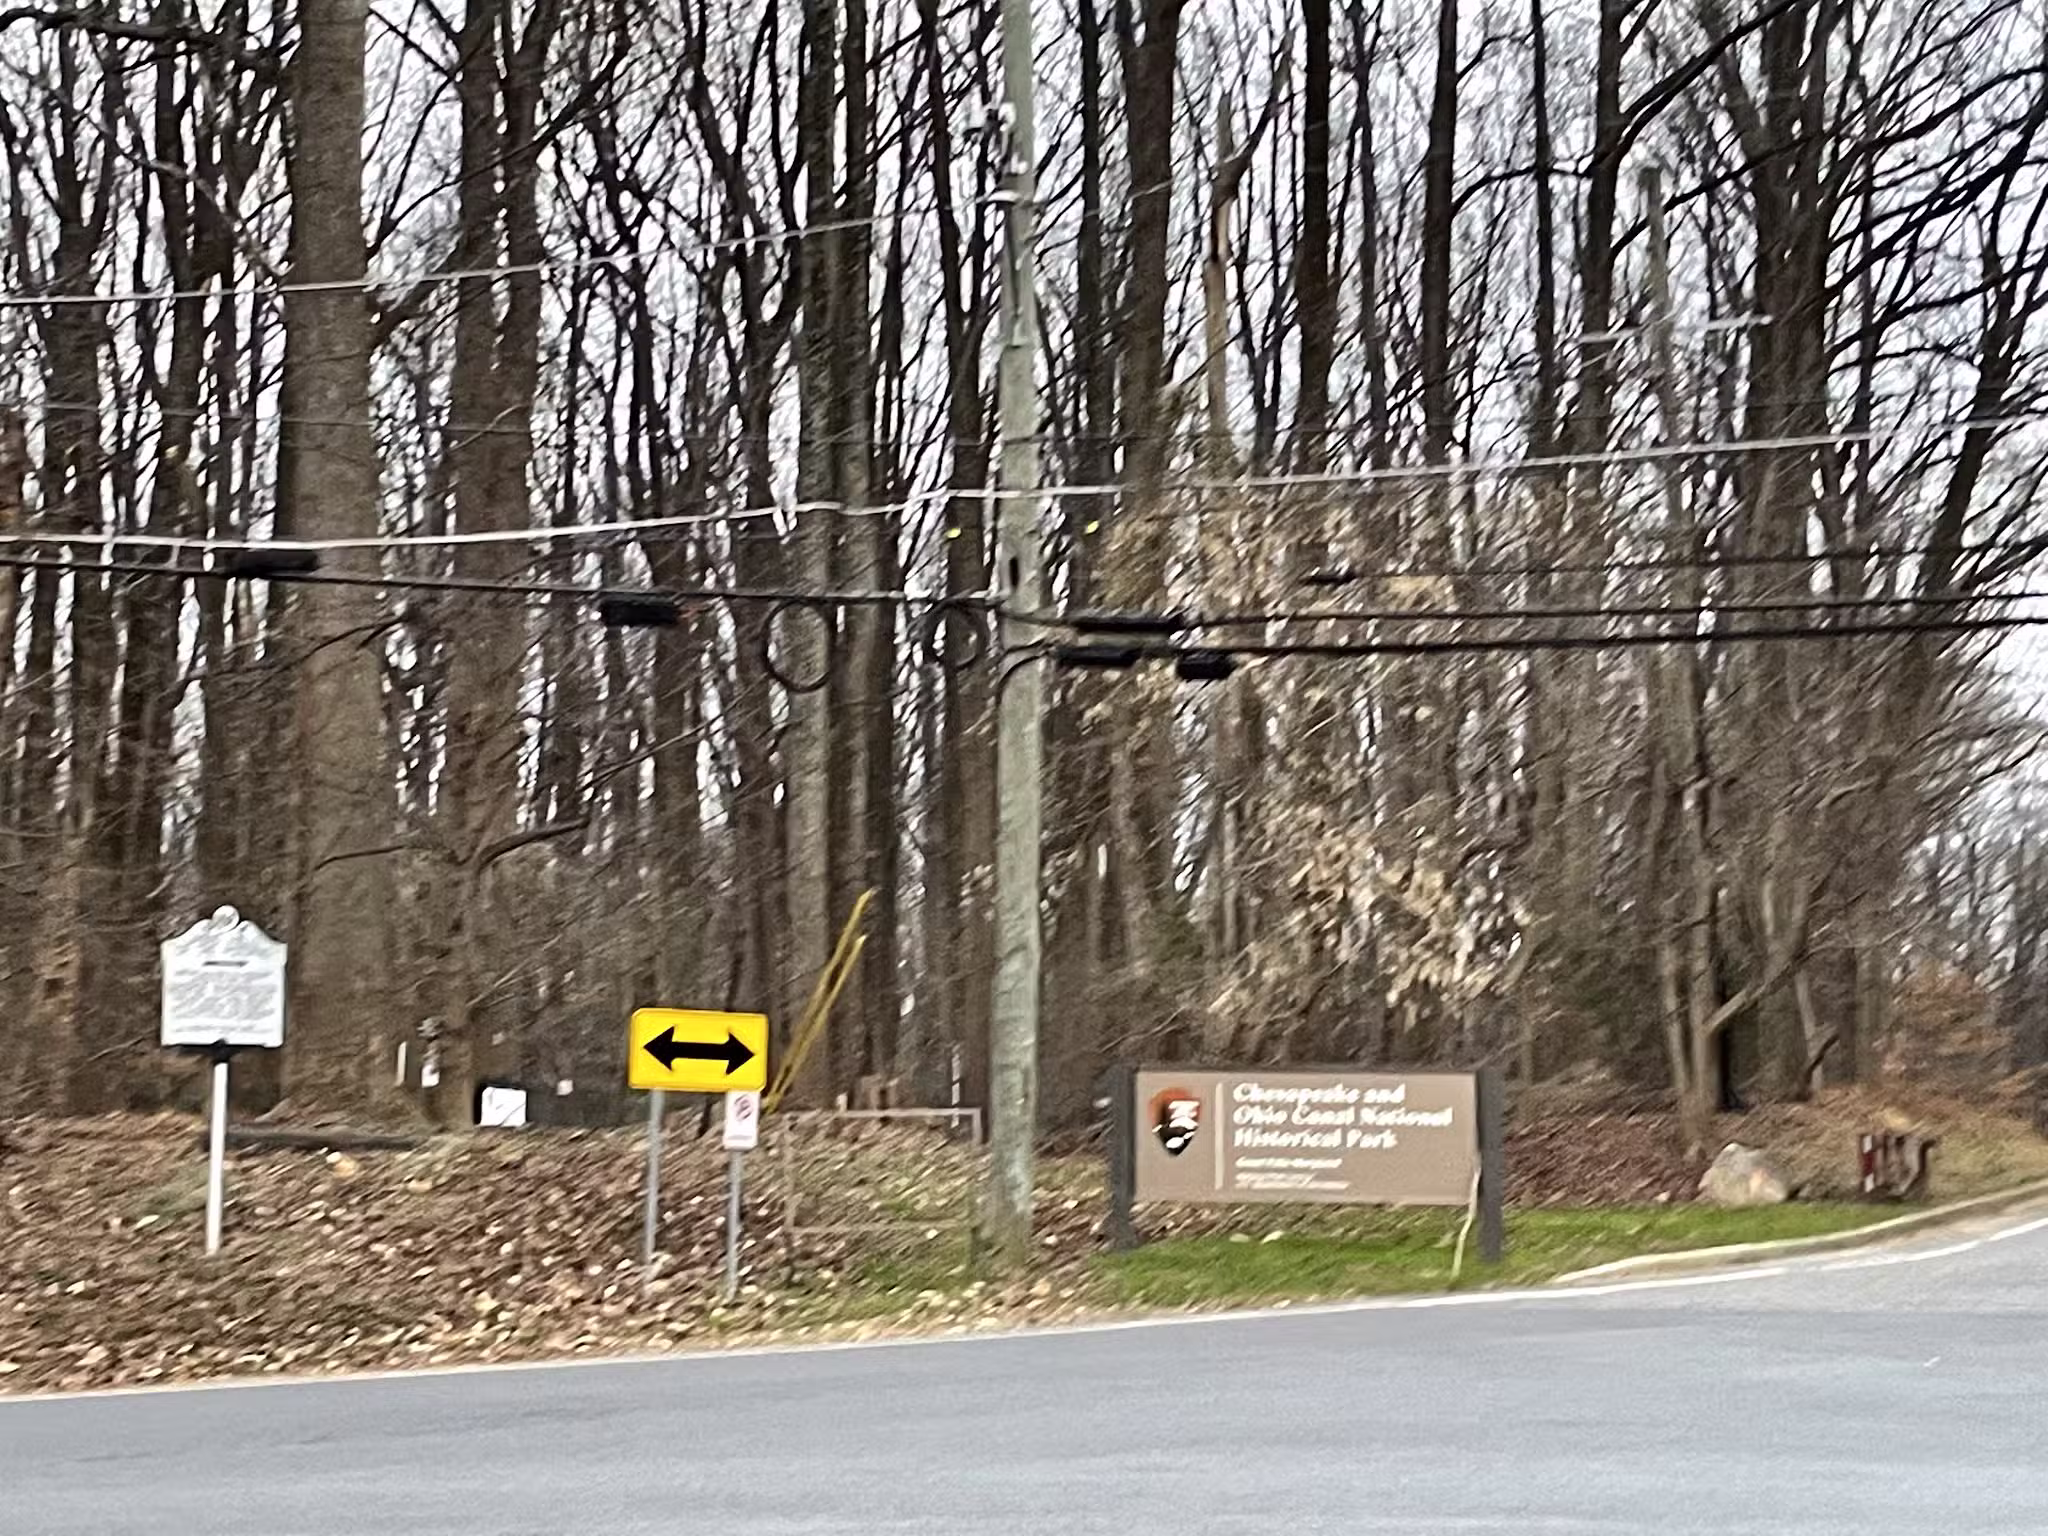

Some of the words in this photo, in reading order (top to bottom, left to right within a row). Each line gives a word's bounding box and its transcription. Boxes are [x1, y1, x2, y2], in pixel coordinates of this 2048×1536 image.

[1363, 1083, 1406, 1103] and
[1233, 1105, 1288, 1125] Ohio
[1291, 1106, 1355, 1126] Canal
[1360, 1106, 1454, 1127] National
[1233, 1127, 1343, 1148] Historical
[1346, 1129, 1399, 1149] Park
